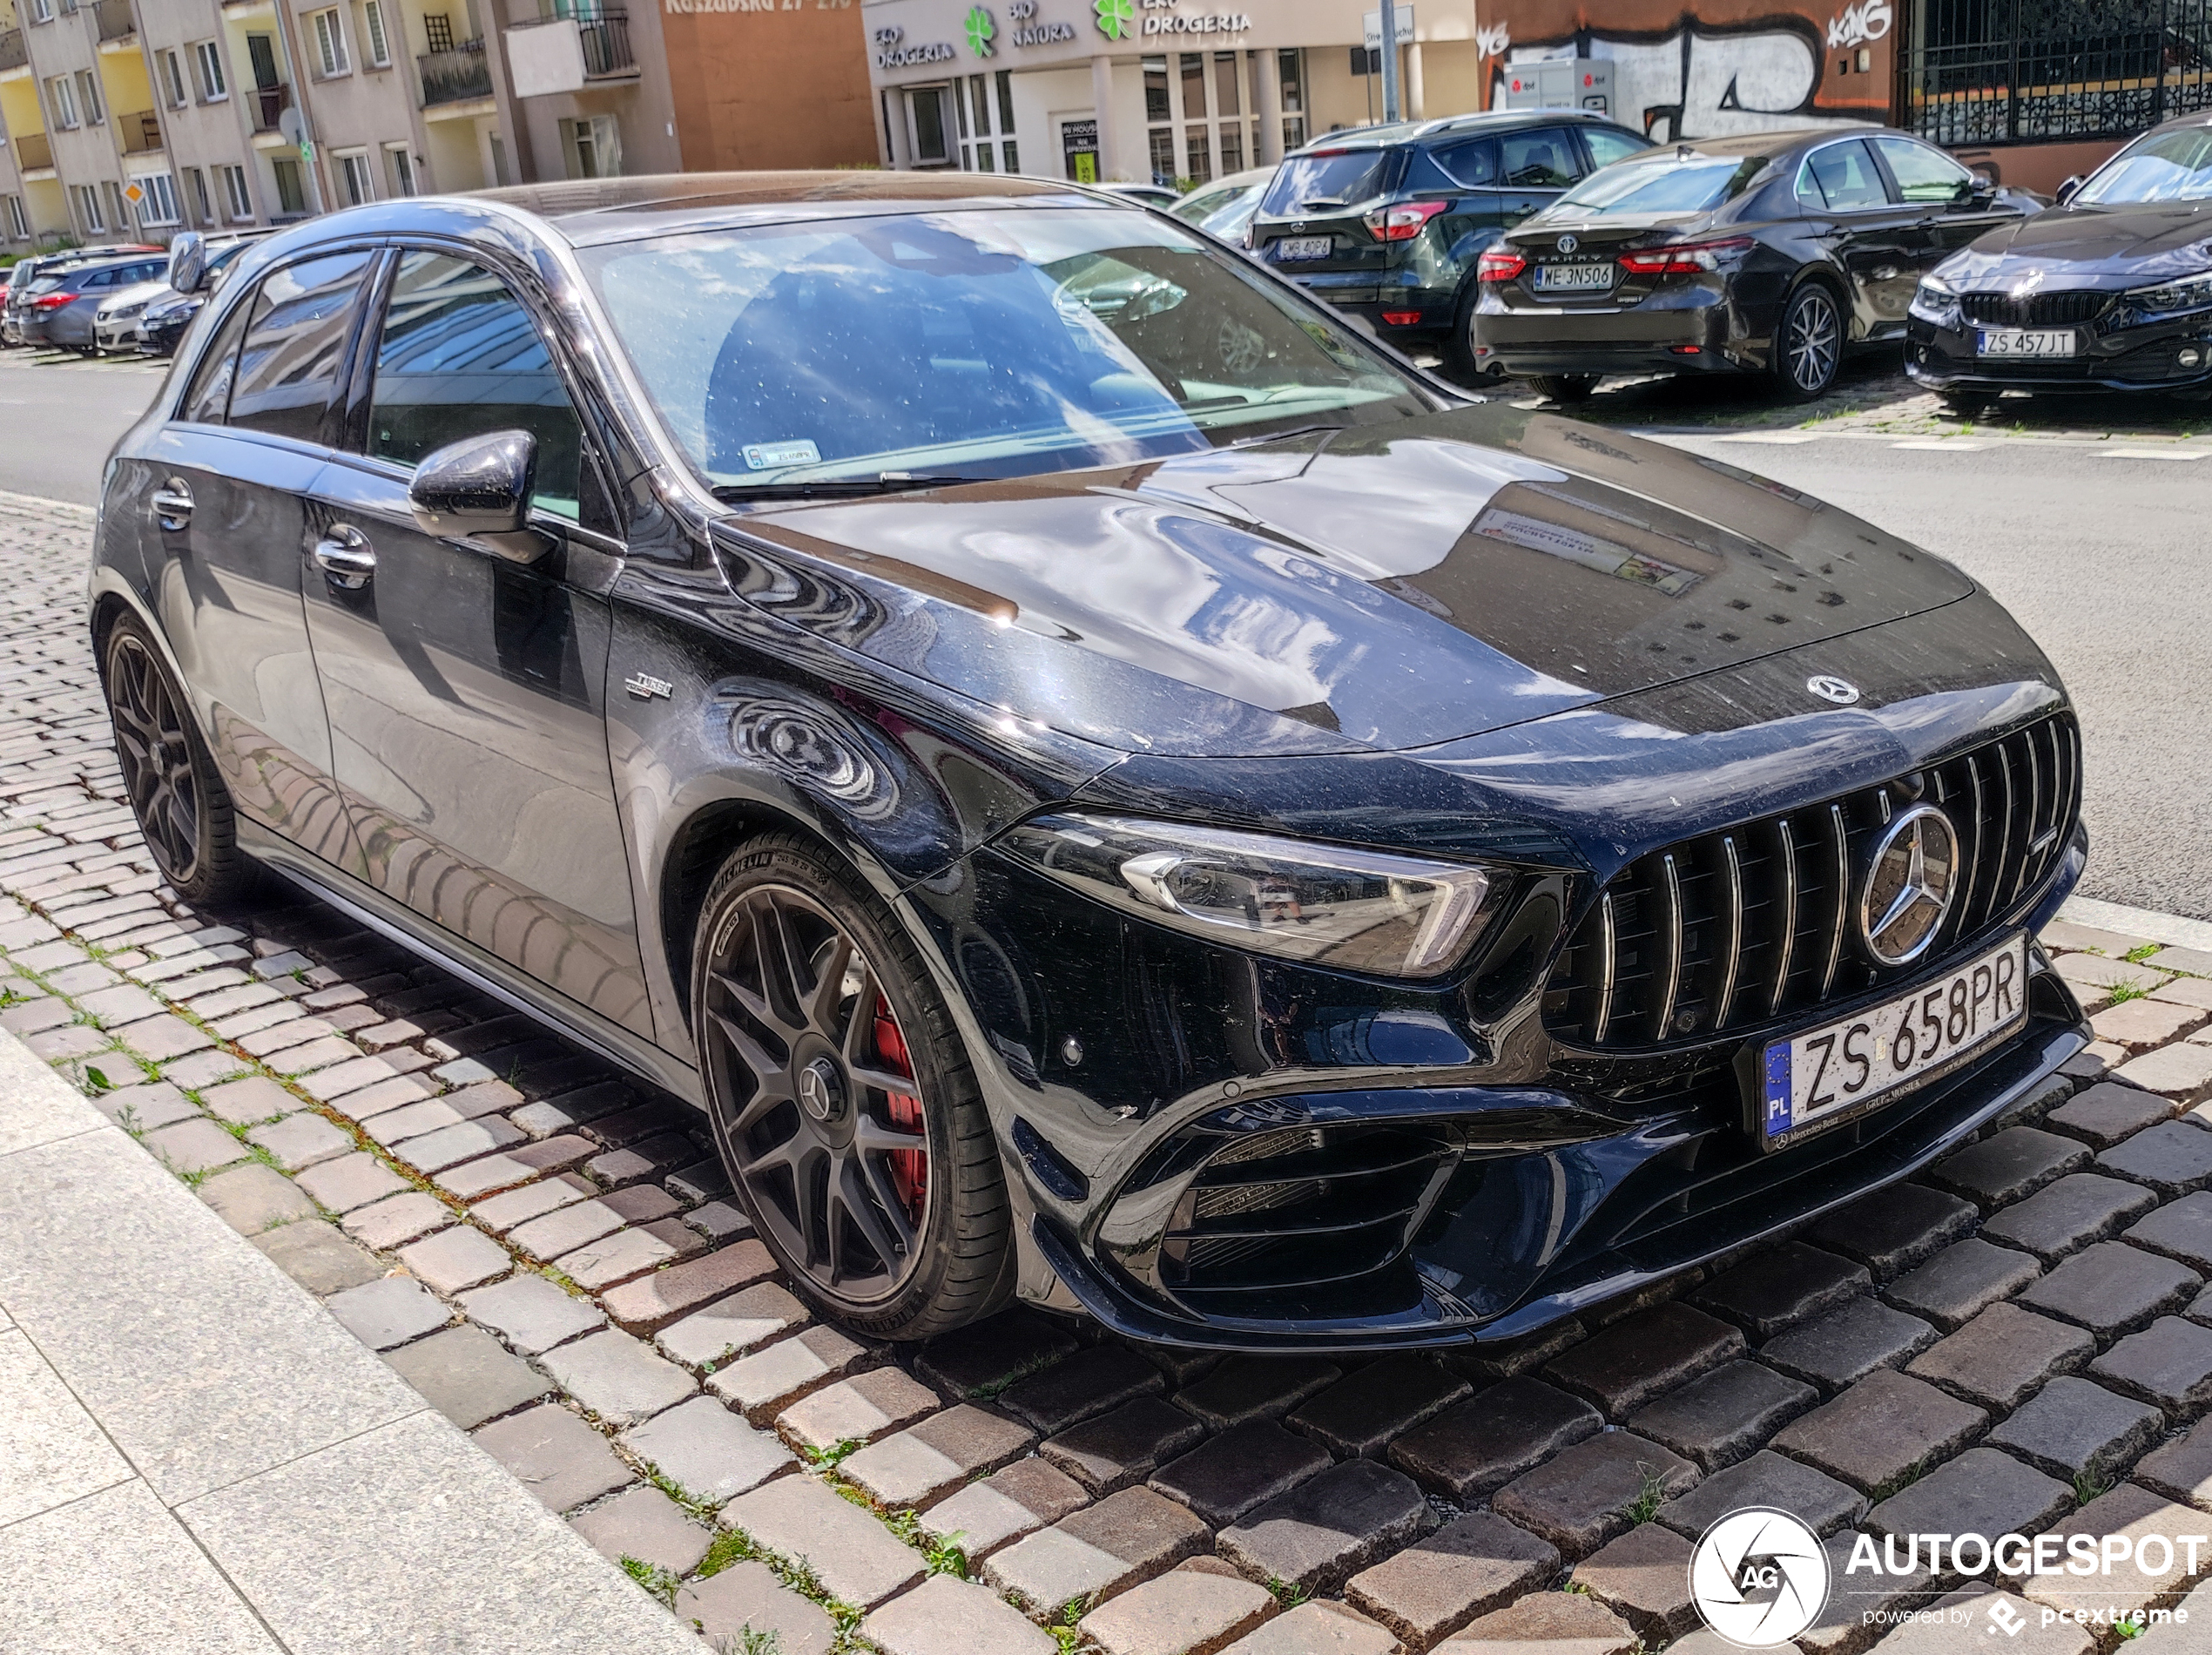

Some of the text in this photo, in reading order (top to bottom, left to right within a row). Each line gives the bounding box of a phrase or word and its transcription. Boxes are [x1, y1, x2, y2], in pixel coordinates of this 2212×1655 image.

[1009, 3, 1035, 20] BIO
[1012, 24, 1073, 46] NATURA
[1144, 14, 1252, 35] DROGERIA
[876, 29, 899, 44] EKO
[876, 44, 954, 69] DROGERIA
[1544, 267, 1610, 286] WE 3N506
[1987, 334, 2008, 353] ZS
[637, 672, 673, 695] TURBO
[1805, 950, 2014, 1112] ZS 658PR
[1769, 1098, 1789, 1120] PL
[1790, 1116, 1839, 1143] Mercedes-Benz
[1865, 1096, 1890, 1111] GRUP
